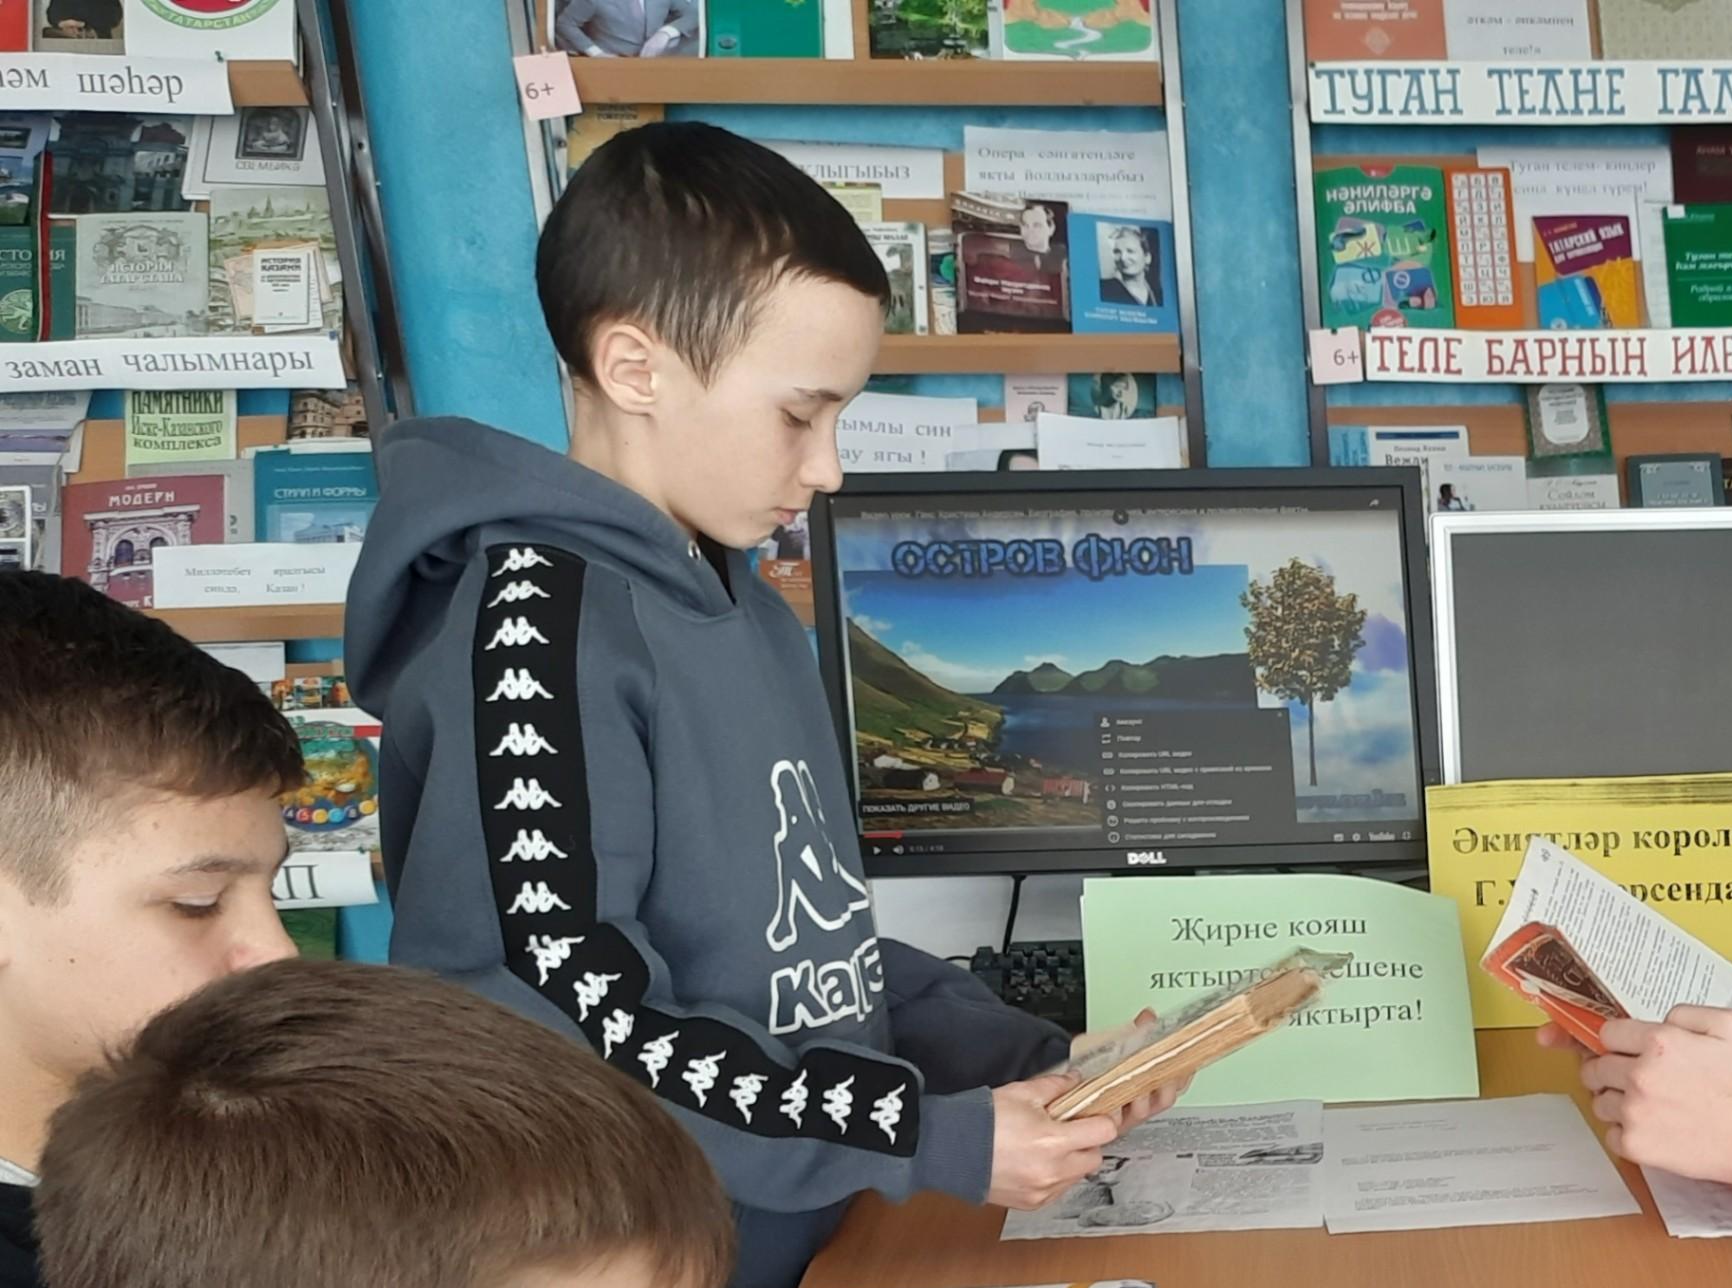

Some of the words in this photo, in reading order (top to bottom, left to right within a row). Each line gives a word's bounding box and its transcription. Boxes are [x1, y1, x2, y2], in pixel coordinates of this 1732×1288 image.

[0, 66, 49, 89] әм
[77, 65, 184, 104] шәһәр
[525, 79, 556, 100] 6+
[1315, 68, 1463, 116] ТУГАН
[1487, 67, 1625, 116] ТЕЛНЕ
[1325, 184, 1433, 203] НӘНИЛӘРГӘ
[1343, 199, 1417, 214] ӘЛИФБА
[5, 357, 104, 380] заман
[122, 350, 314, 378] чалымнары
[1333, 348, 1360, 365] 6+
[133, 435, 222, 450] комплекса
[108, 490, 175, 507] МОДЕРН
[892, 537, 1065, 579] ОСТРОВ
[1171, 915, 1279, 947] Җирне
[1288, 915, 1367, 938] кояш
[1329, 959, 1424, 983] ешене
